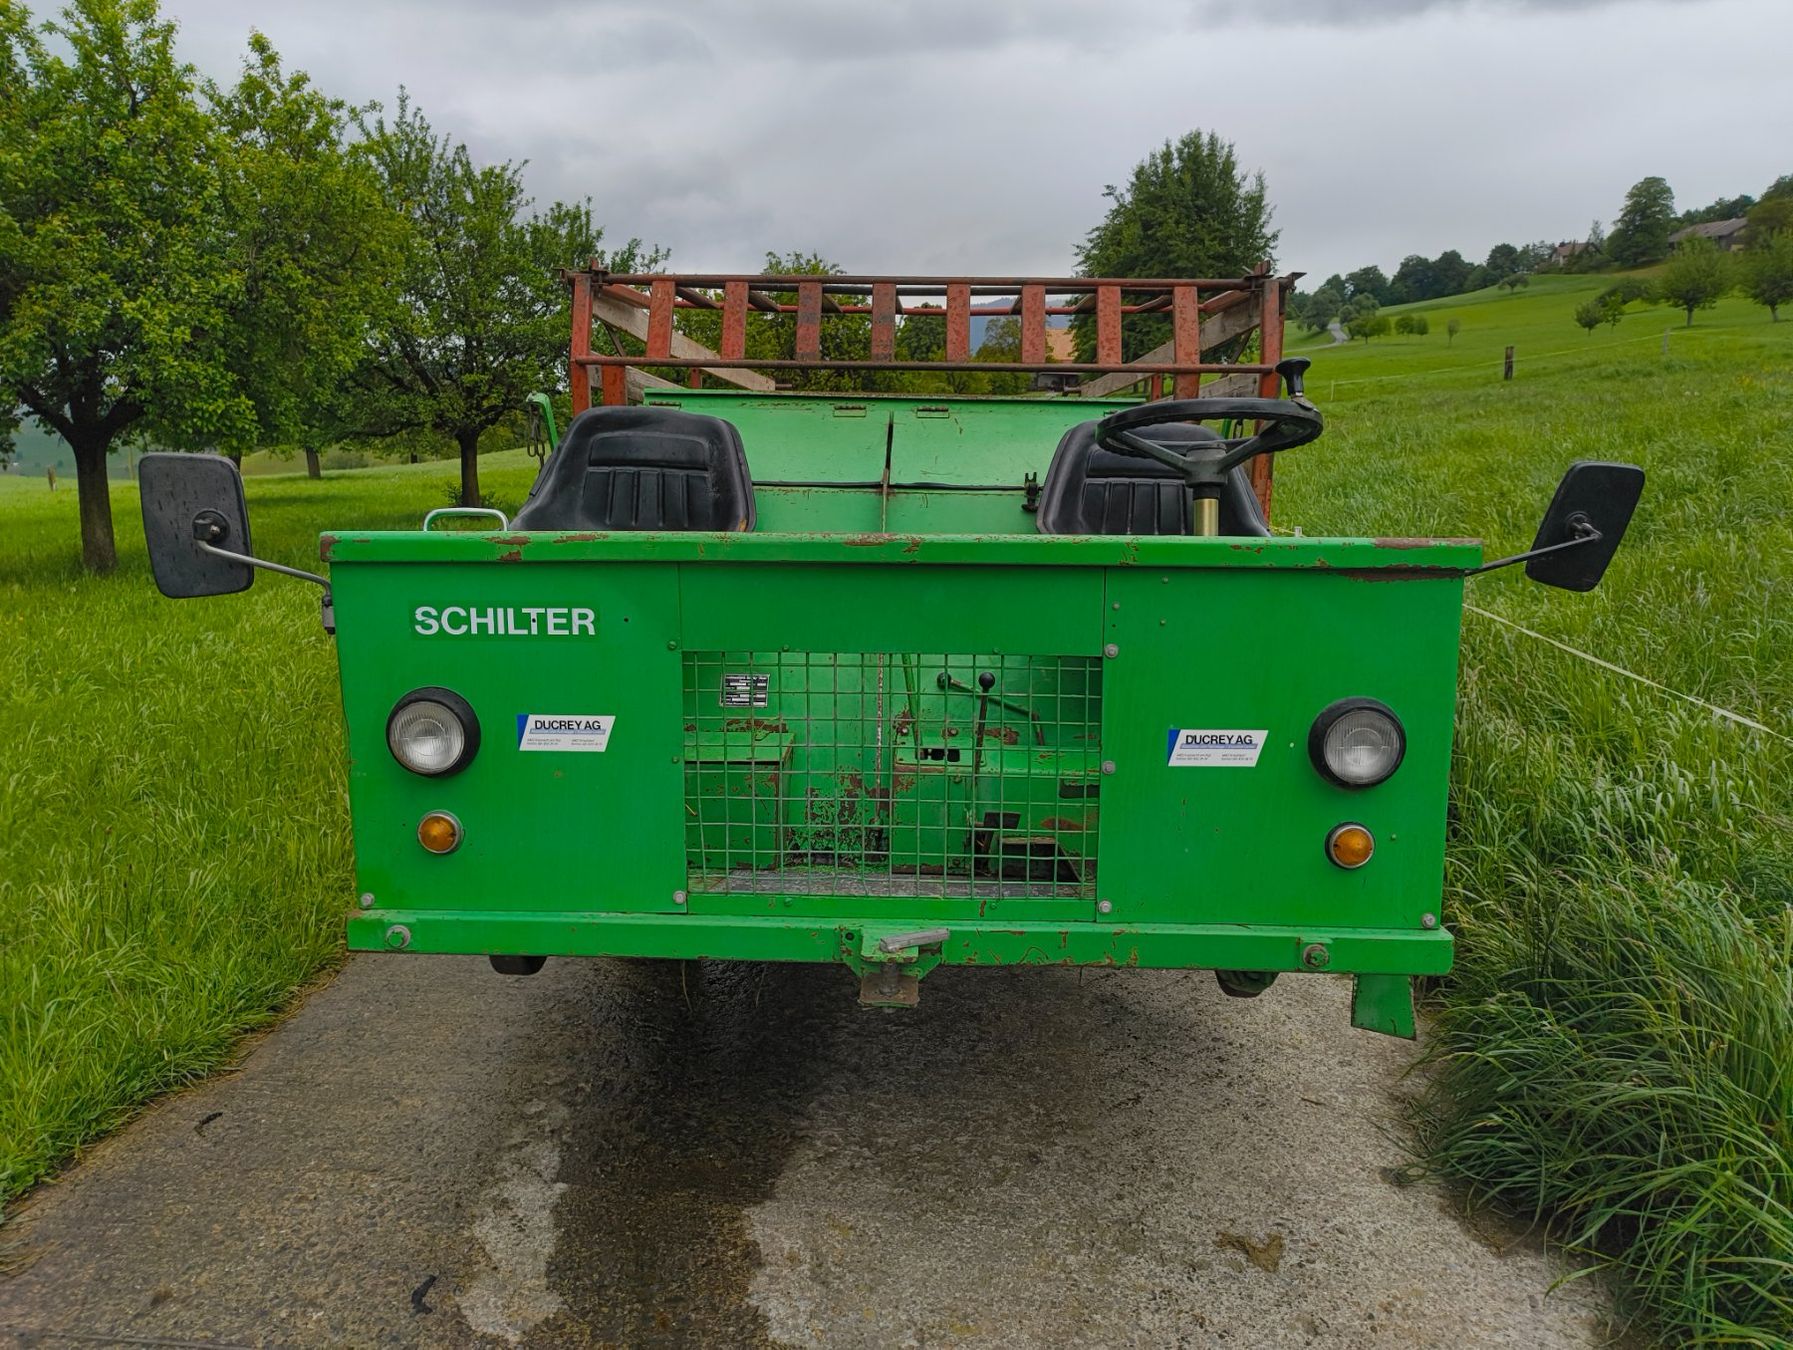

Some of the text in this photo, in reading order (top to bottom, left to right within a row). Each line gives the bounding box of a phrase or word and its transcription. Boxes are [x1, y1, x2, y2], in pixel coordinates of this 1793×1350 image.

[414, 606, 596, 636] SCHILTER
[534, 720, 601, 730] DUCREY AG
[1185, 734, 1253, 745] DUCREY AG
